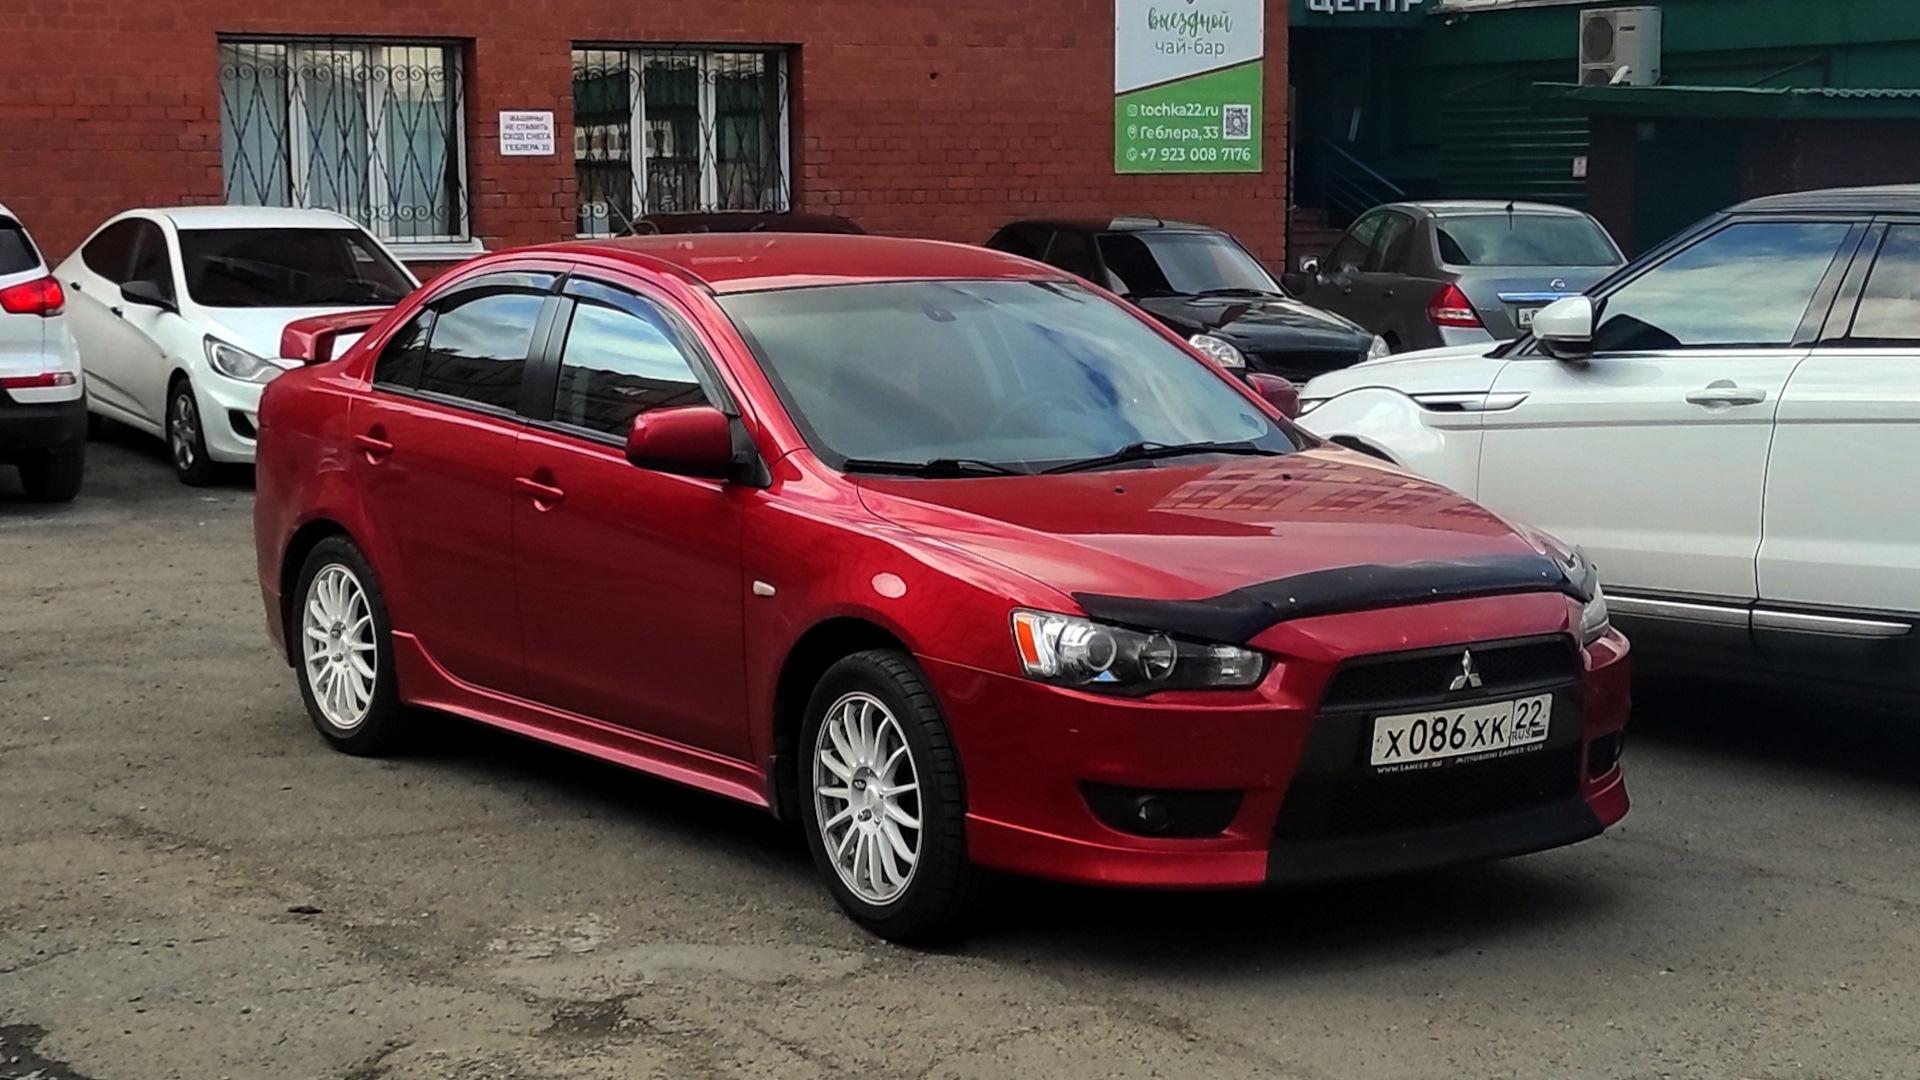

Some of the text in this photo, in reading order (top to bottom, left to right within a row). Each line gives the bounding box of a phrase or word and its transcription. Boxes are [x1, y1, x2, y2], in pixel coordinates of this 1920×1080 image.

[1155, 39, 1225, 58] чай-бар
[1140, 102, 1219, 117] tochka22.ru
[503, 132, 551, 141] СХОД СНЕГА
[1140, 147, 1251, 161] +7 923 008 7176
[1515, 700, 1543, 730] 22
[1511, 727, 1531, 742] RUS
